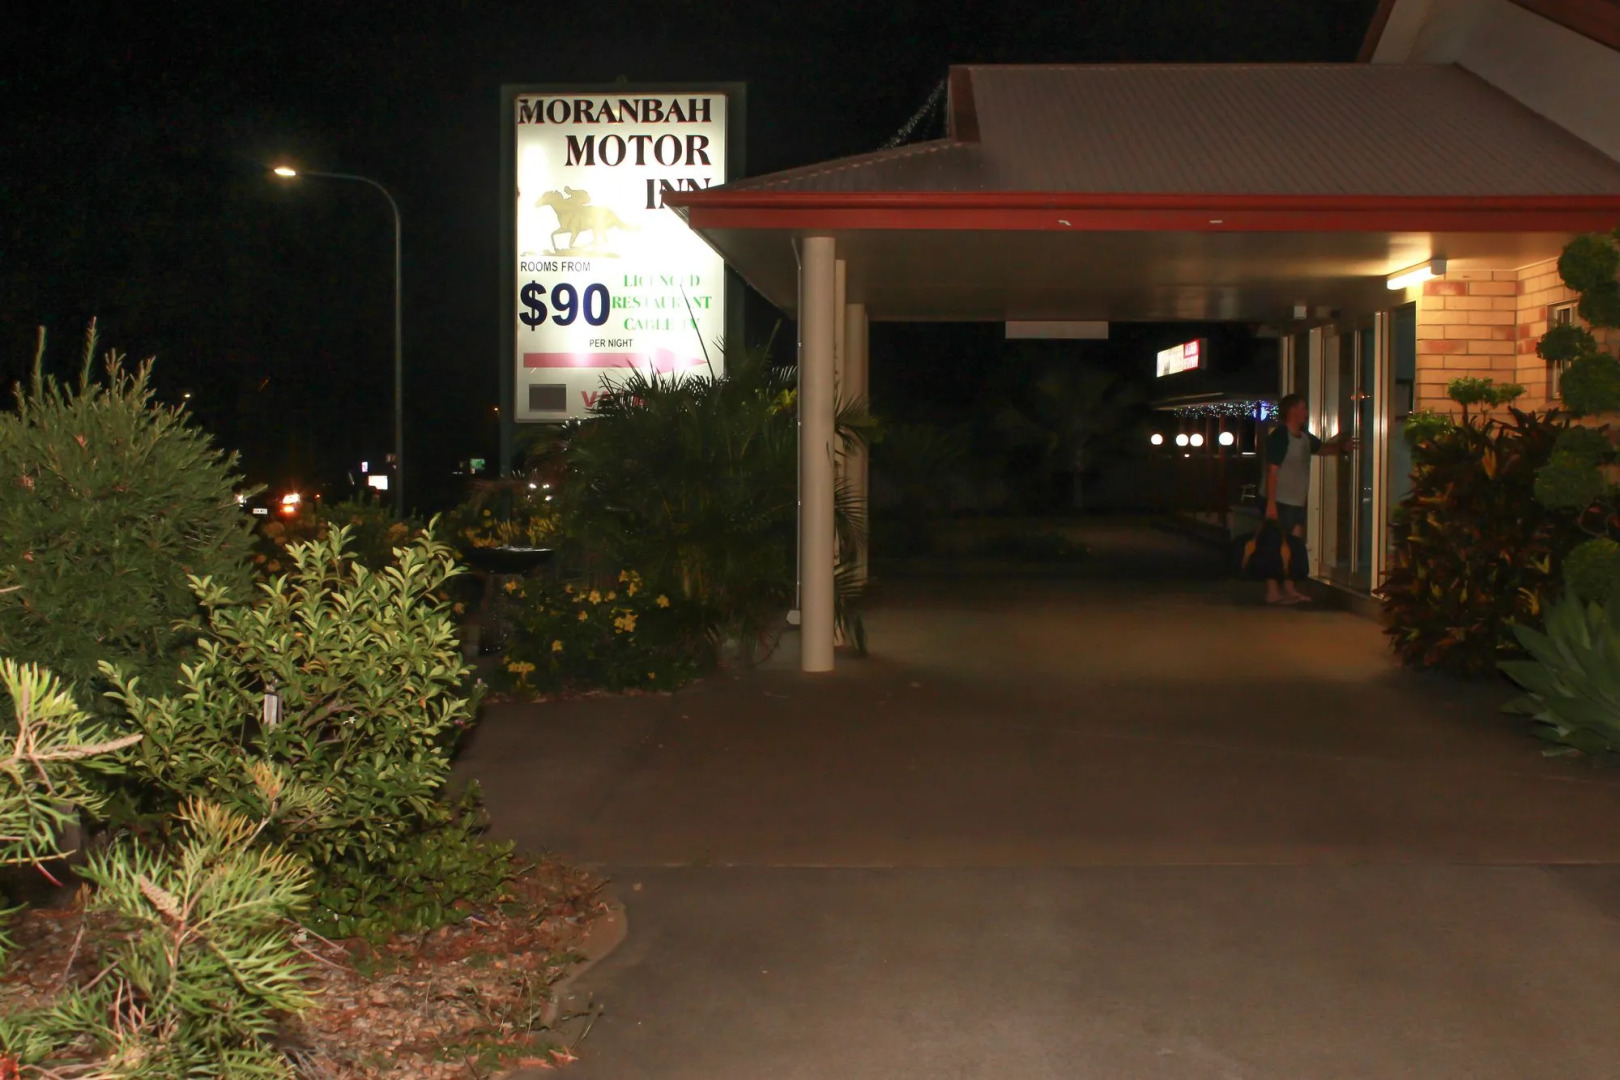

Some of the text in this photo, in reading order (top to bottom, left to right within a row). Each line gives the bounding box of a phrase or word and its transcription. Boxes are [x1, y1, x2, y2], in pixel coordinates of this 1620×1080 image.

[518, 98, 712, 124] MORANBAH
[565, 134, 712, 167] MOTOR
[520, 261, 591, 272] ROOMS FROM
[623, 274, 701, 287] LICNCD
[518, 280, 611, 331] $90
[612, 295, 712, 309] RESAURNT
[589, 338, 633, 348] PER NIGHT
